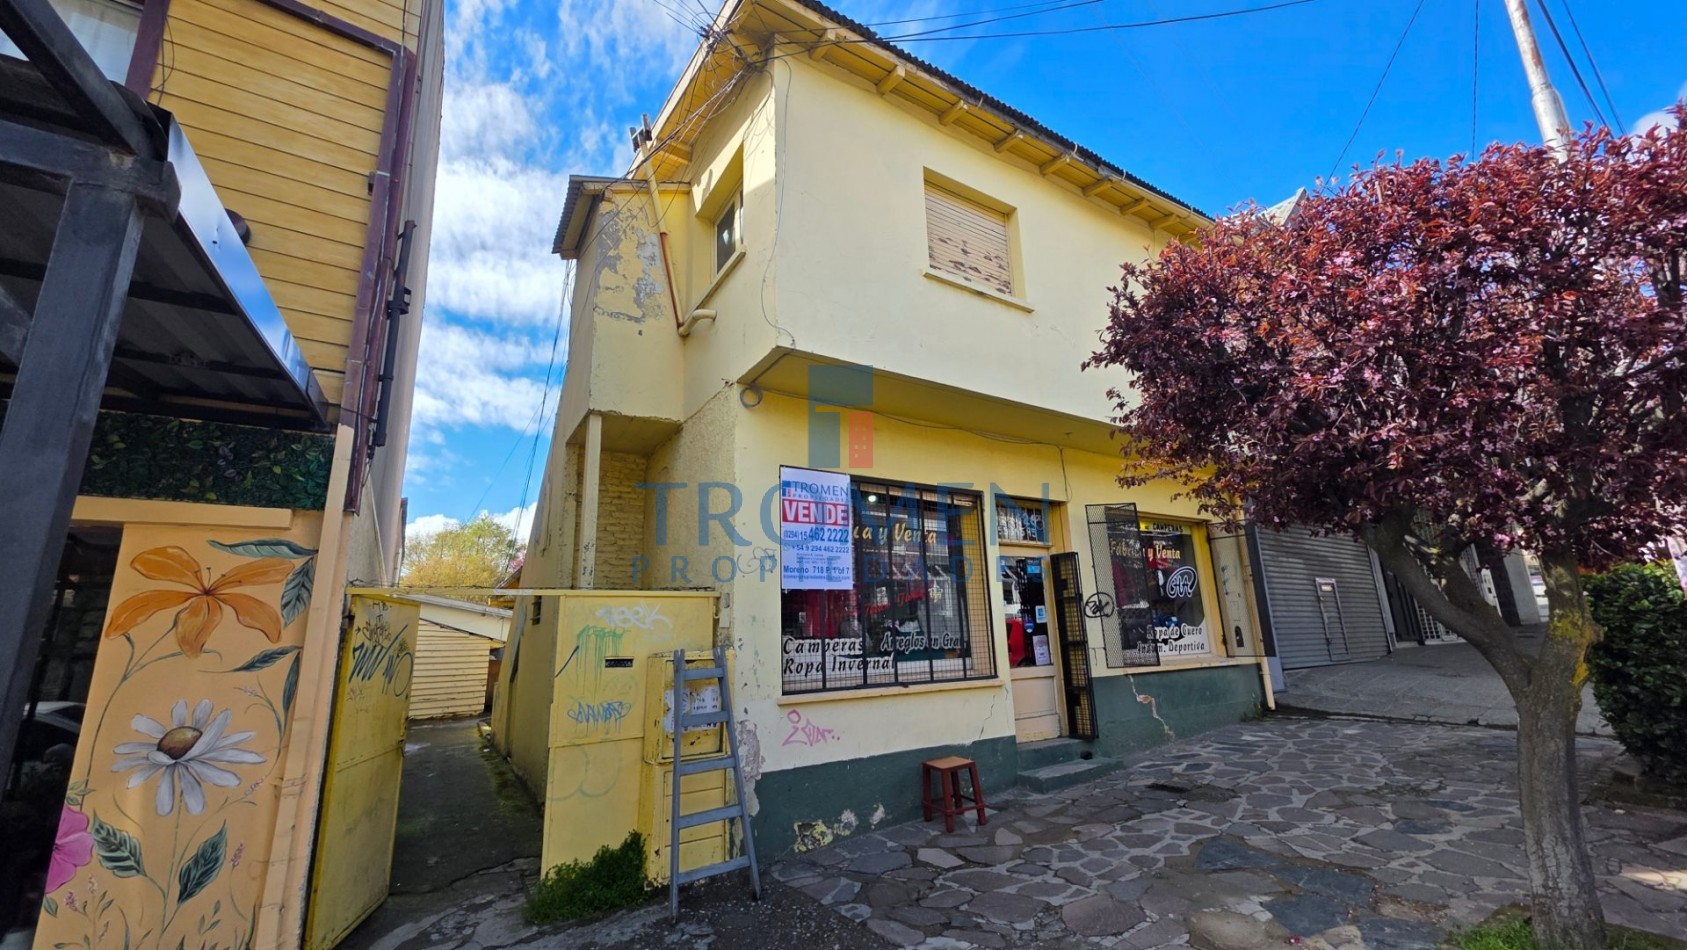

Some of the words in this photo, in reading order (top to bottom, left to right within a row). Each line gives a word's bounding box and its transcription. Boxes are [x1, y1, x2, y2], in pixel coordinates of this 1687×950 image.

[792, 481, 849, 497] TROMEN
[783, 501, 848, 525] VENDE
[809, 527, 825, 541] 462
[827, 528, 849, 543] 2222
[1156, 544, 1181, 559] Venta
[783, 565, 809, 574] Moreno
[812, 566, 824, 574] 718
[1169, 641, 1205, 655] Deportiva
[783, 658, 823, 677] Ropa
[832, 655, 895, 673] Invernal
